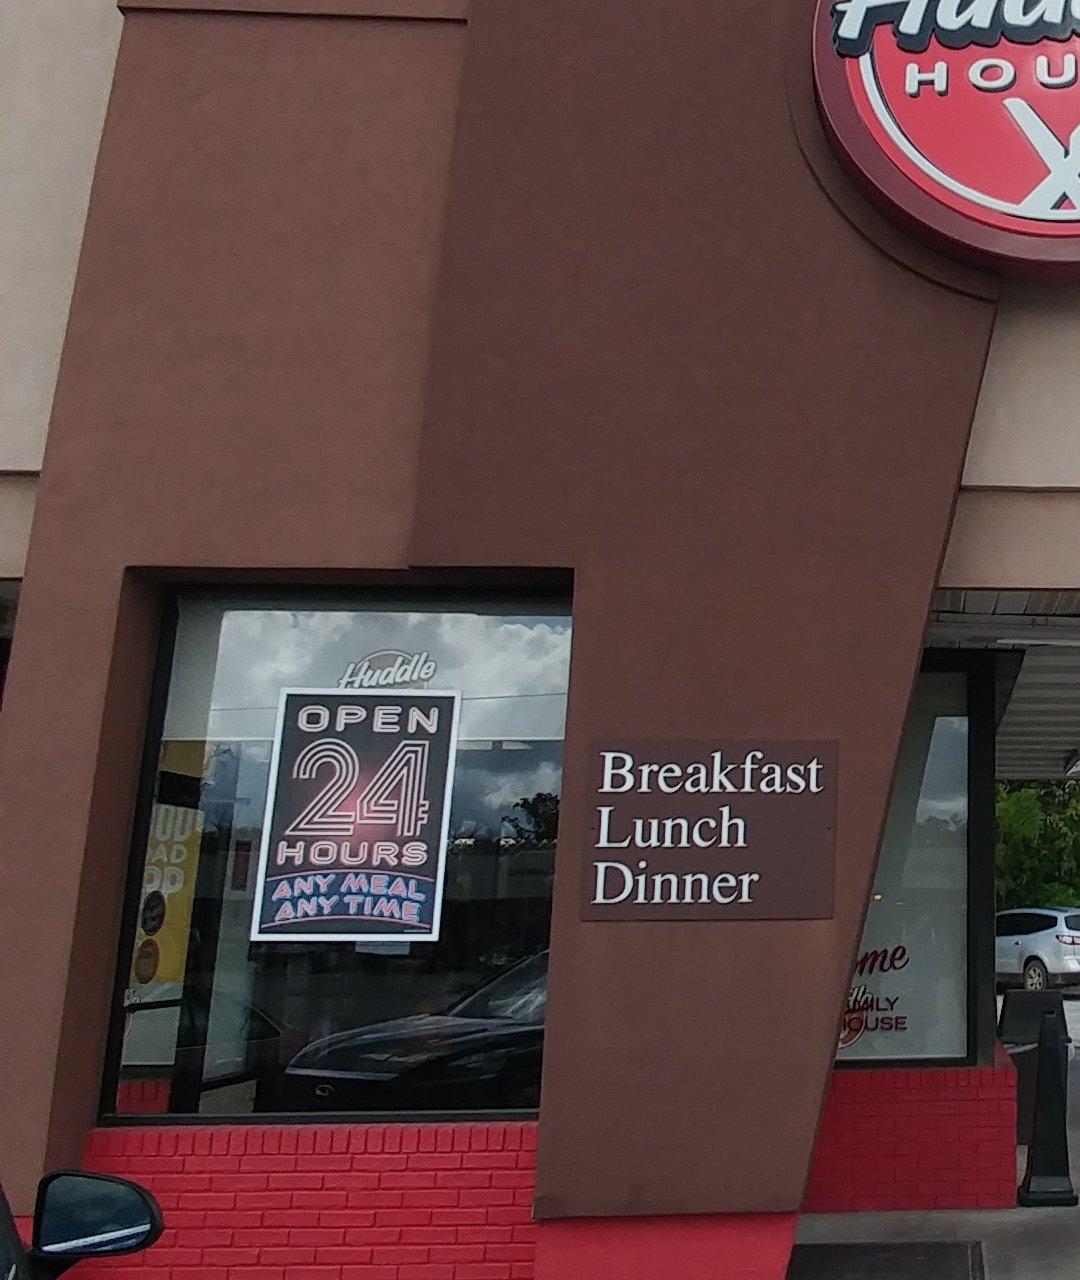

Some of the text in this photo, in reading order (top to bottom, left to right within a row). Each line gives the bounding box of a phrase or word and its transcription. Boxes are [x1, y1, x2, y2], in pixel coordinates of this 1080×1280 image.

[338, 651, 436, 689] Huddle
[297, 704, 439, 733] OPEN
[283, 738, 430, 837] 24
[597, 750, 824, 794] Breakfast
[594, 805, 748, 848] Lunch
[276, 840, 428, 867] HOURS
[271, 872, 426, 902] ANY MEAL
[591, 860, 760, 904] Dinner
[274, 894, 422, 924] ANY TIME
[856, 944, 910, 977] me
